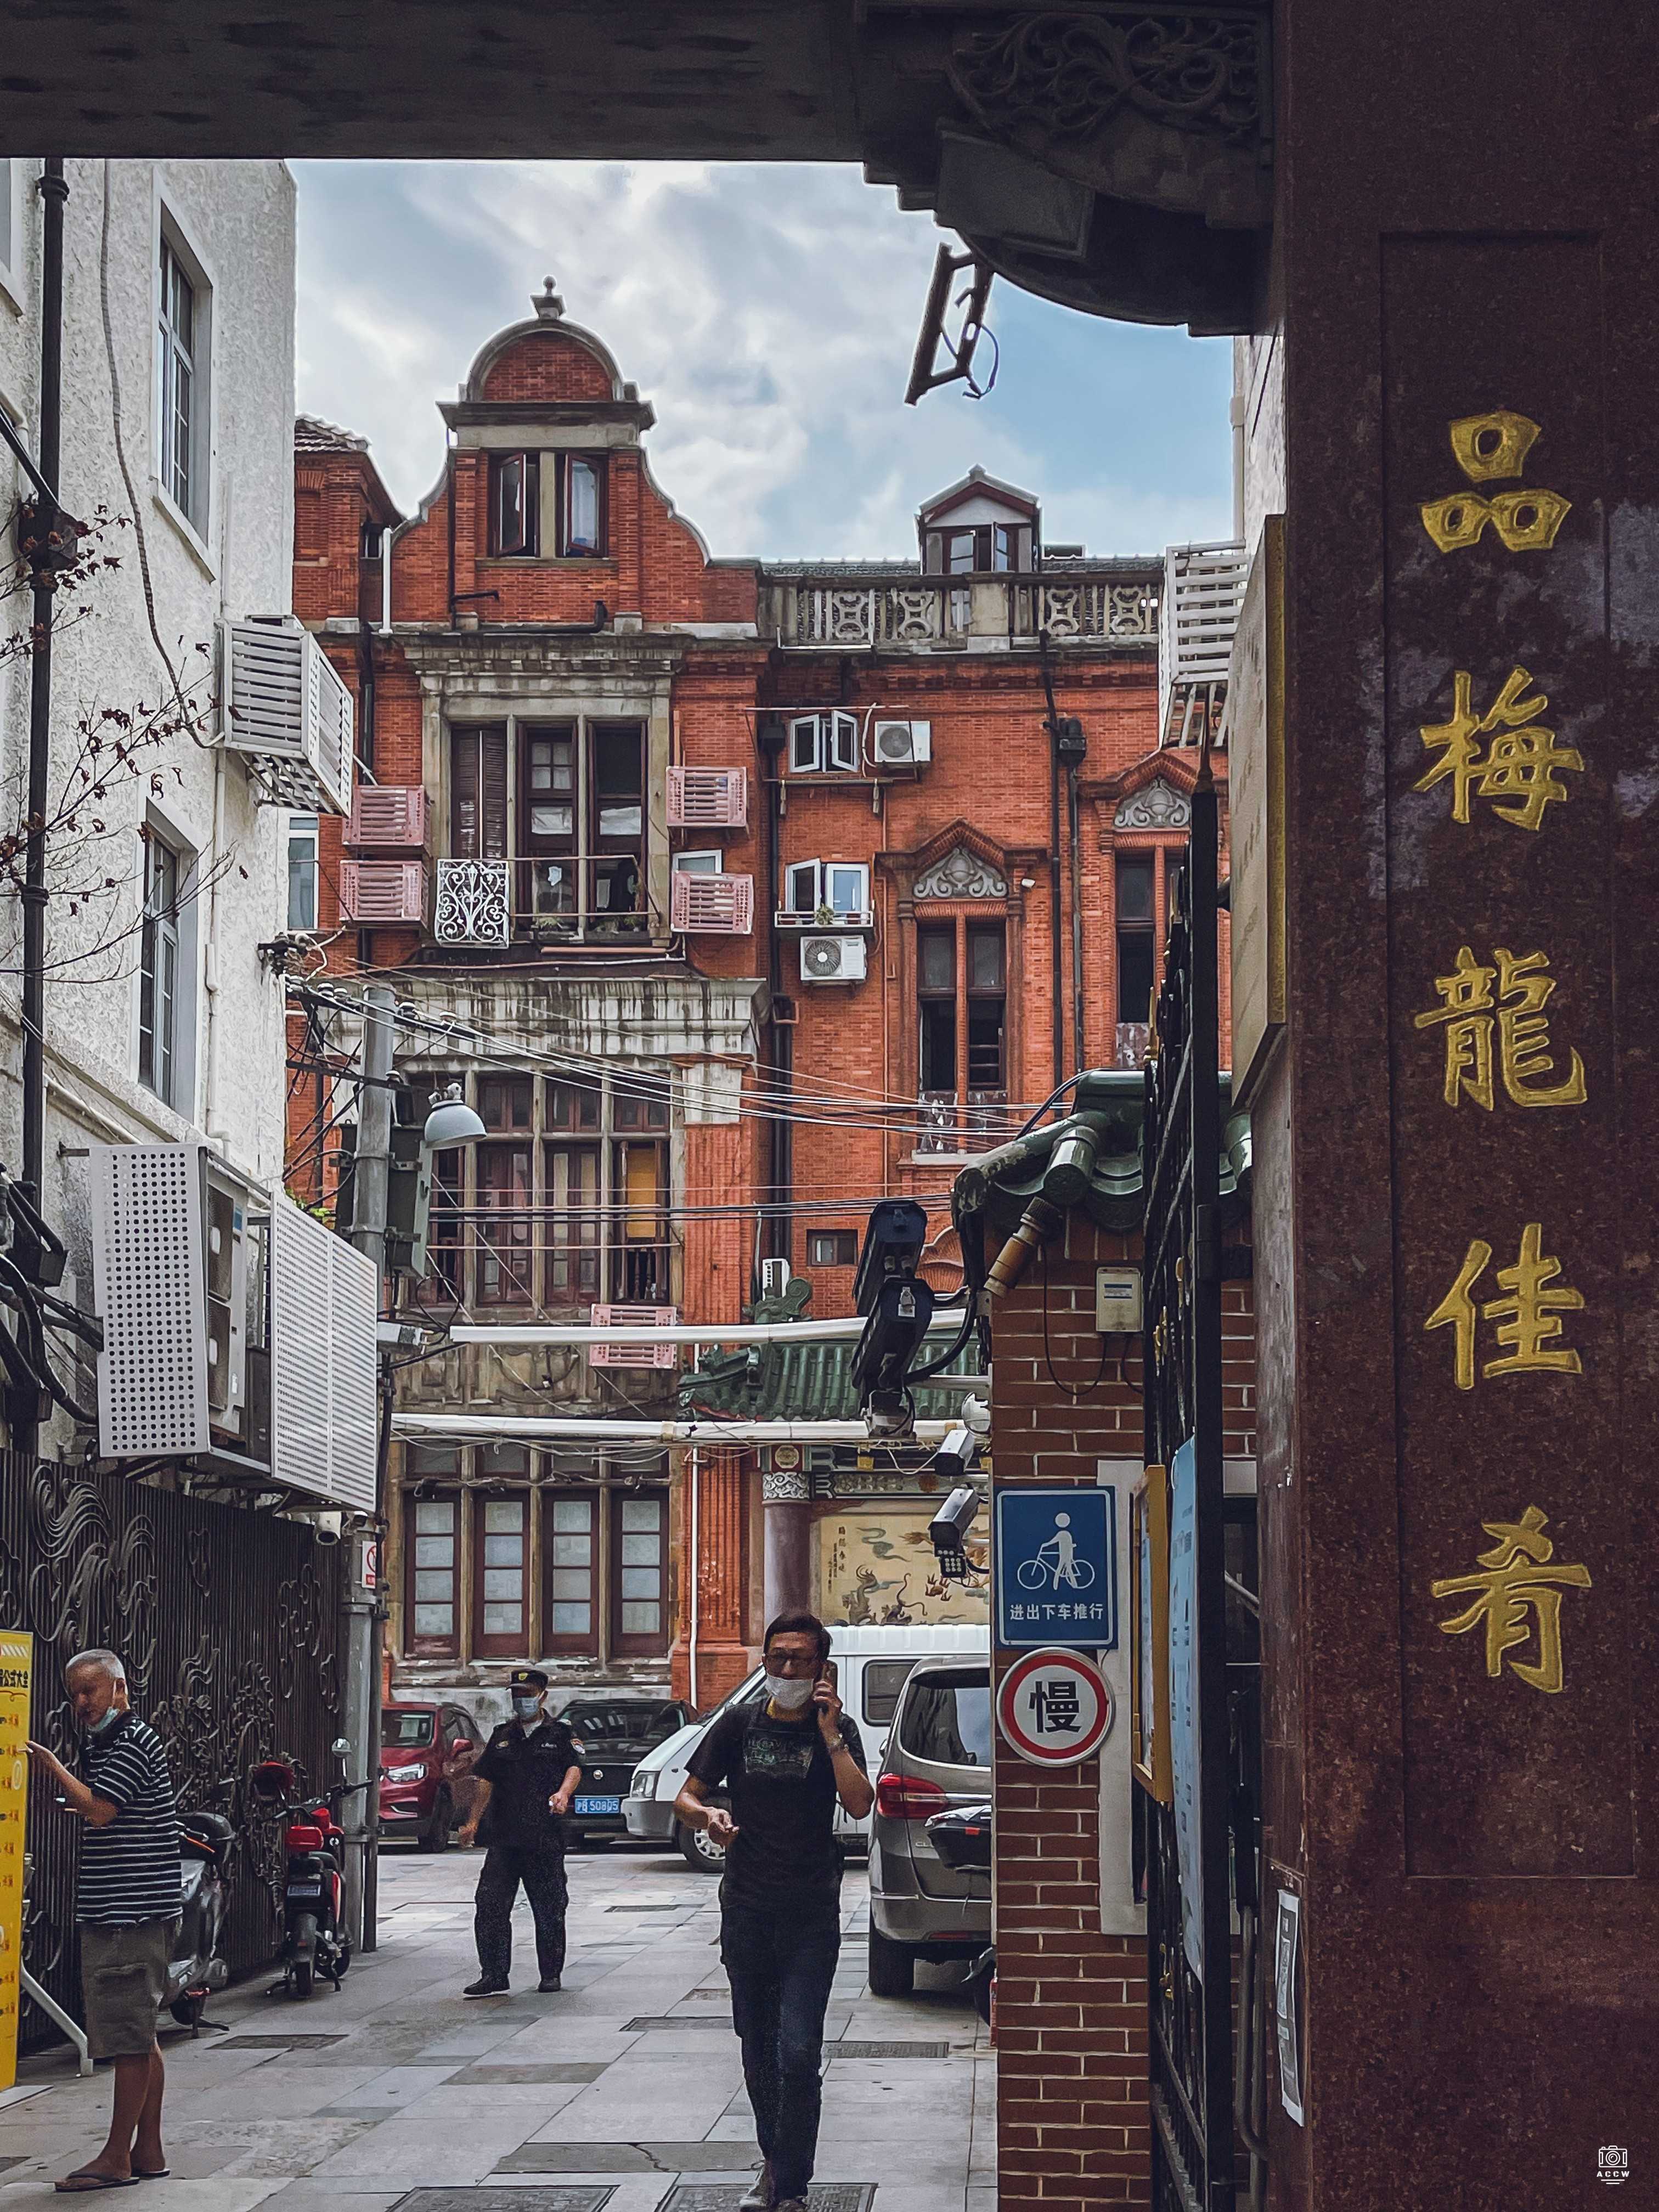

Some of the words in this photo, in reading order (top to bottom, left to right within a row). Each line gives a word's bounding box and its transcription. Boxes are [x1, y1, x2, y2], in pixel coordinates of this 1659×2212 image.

[1010, 1603, 1103, 1620] 进出下车推行
[1028, 1680, 1082, 1734] 慢
